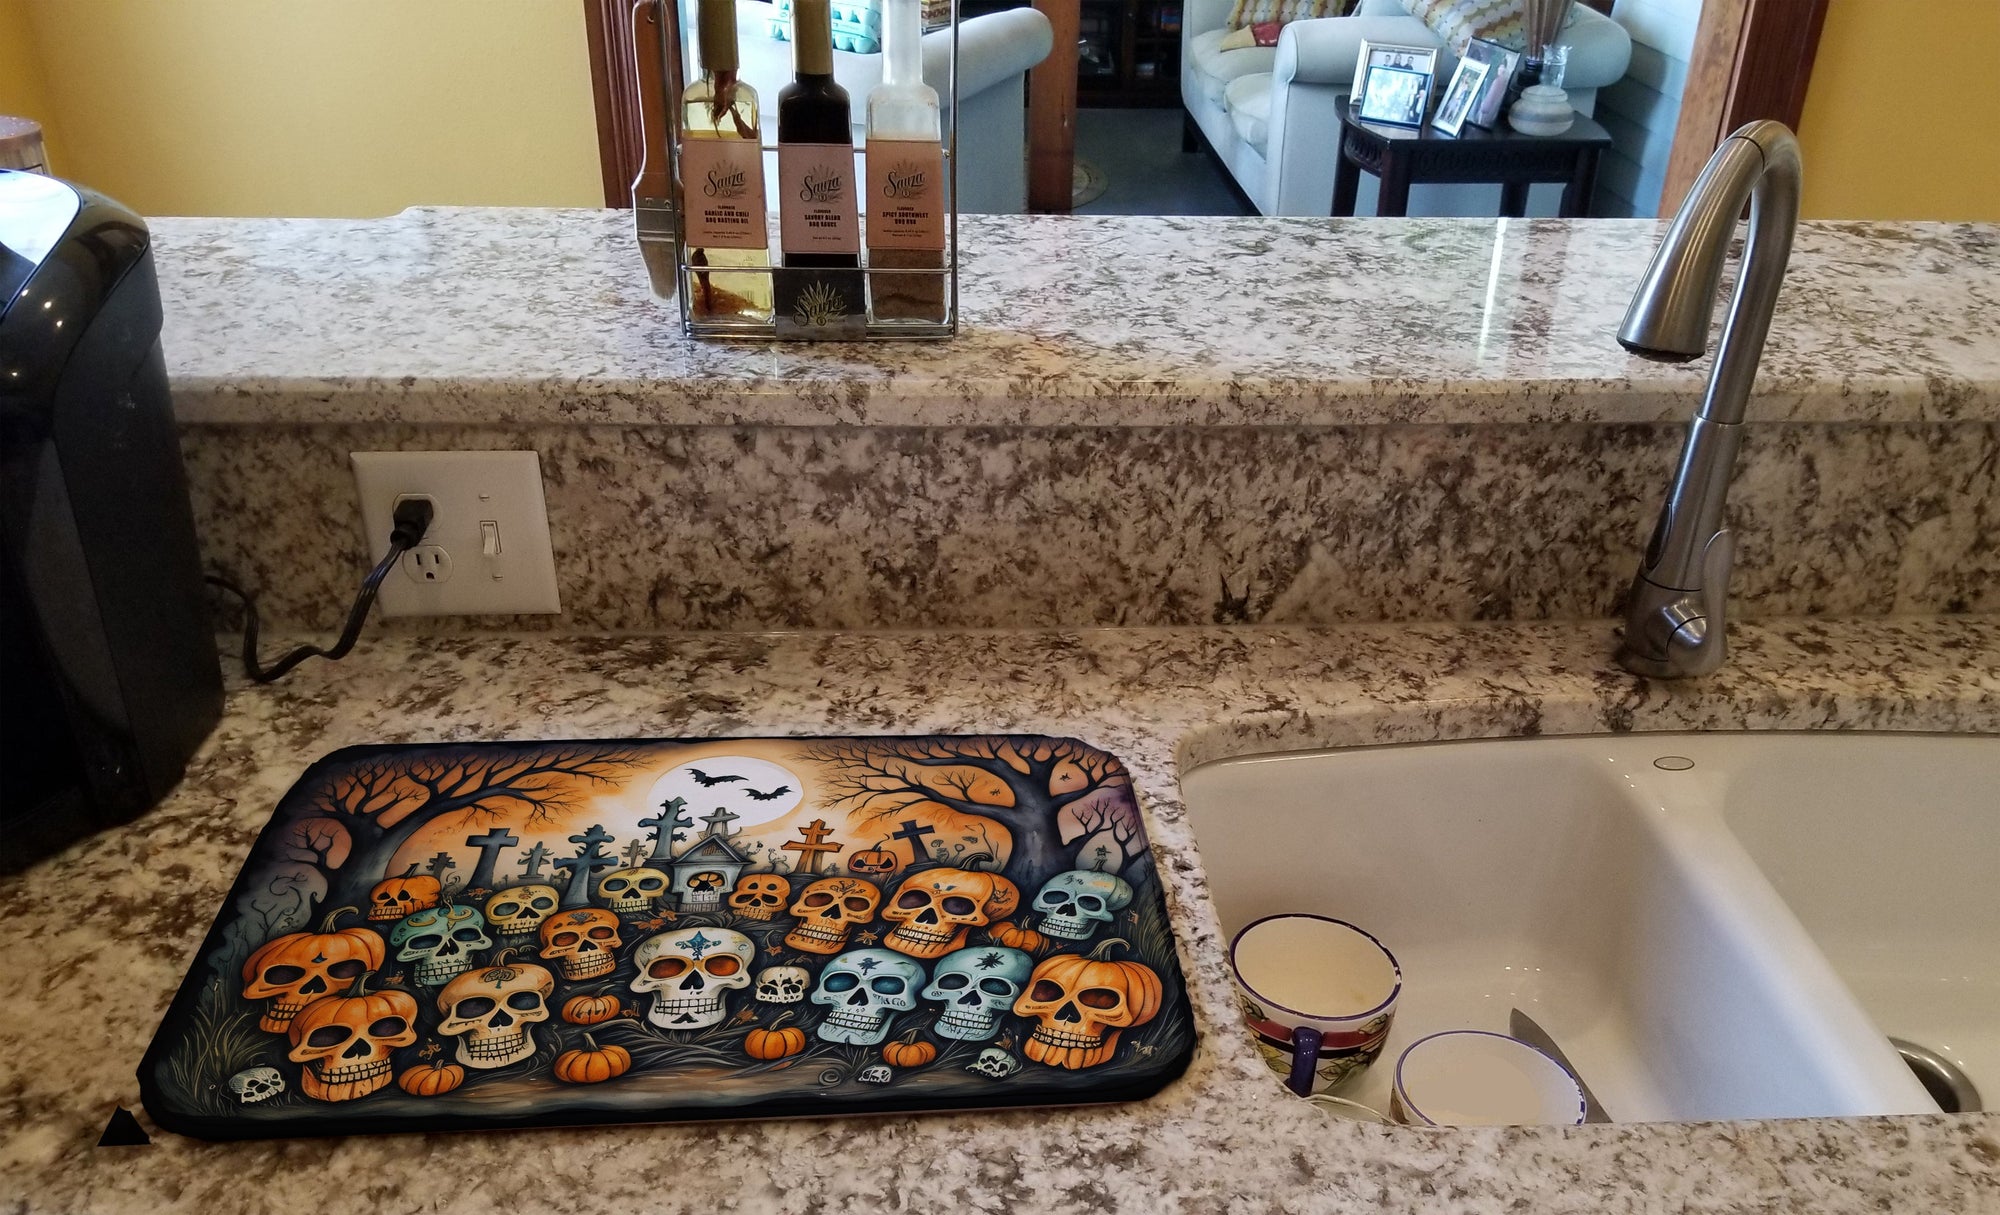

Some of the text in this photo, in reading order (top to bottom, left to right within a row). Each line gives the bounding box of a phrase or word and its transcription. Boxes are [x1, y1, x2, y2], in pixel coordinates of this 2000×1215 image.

[704, 169, 746, 197] Sauza
[800, 175, 842, 202] Sauza
[884, 171, 926, 198] Sauza
